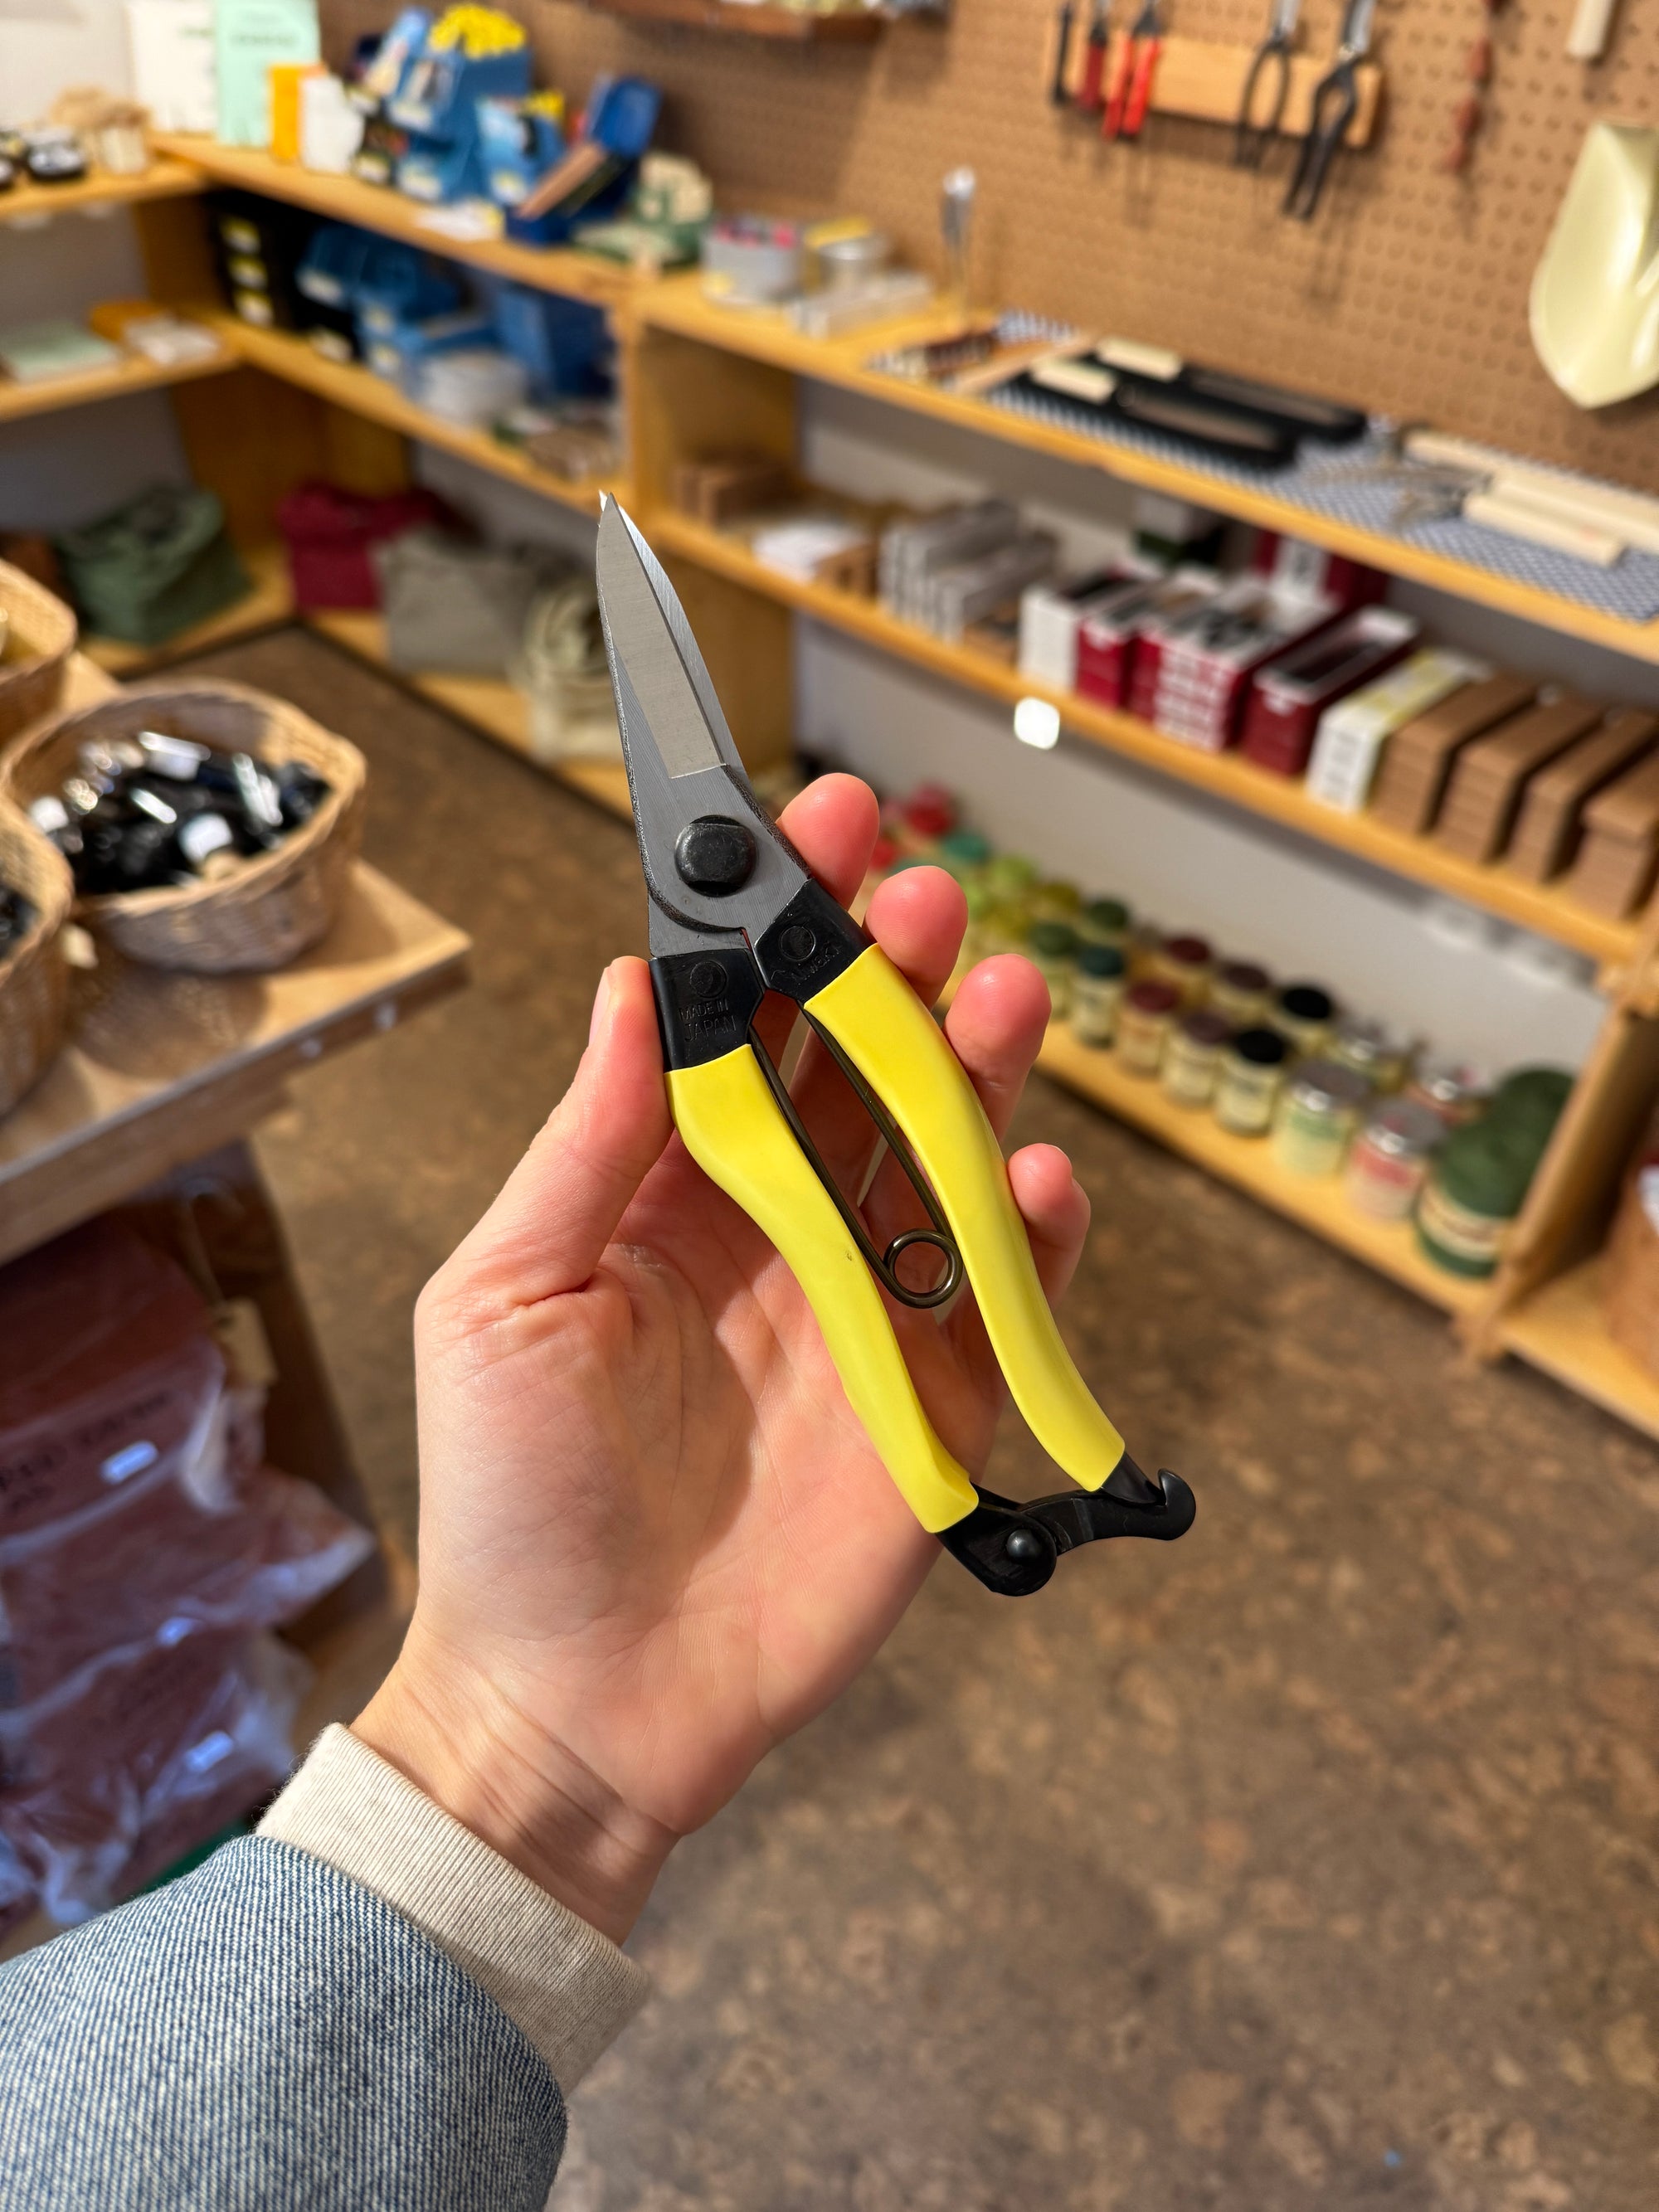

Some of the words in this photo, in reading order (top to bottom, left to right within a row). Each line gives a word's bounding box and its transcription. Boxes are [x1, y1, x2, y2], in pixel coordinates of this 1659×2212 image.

[679, 1002, 715, 1020] MADE
[717, 998, 729, 1013] IN
[684, 1015, 737, 1041] JAPAN
